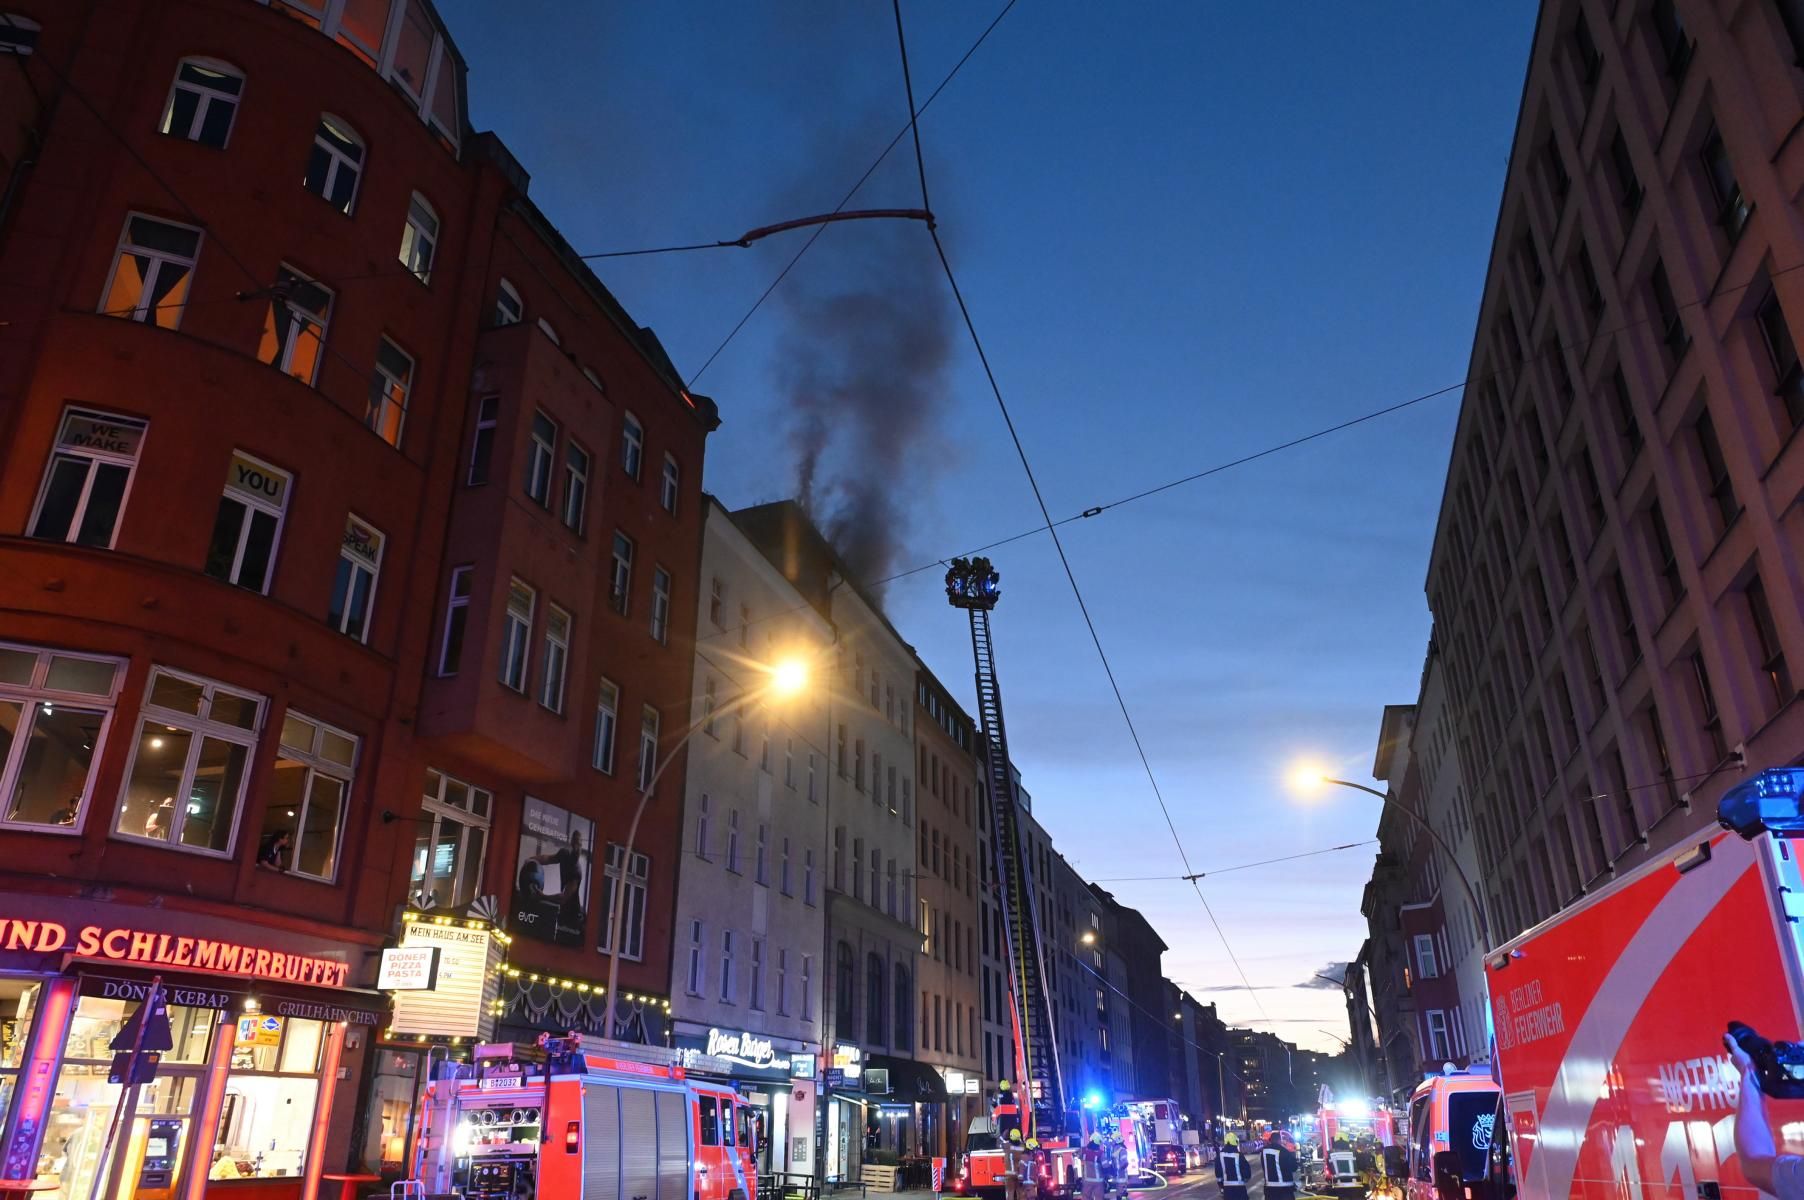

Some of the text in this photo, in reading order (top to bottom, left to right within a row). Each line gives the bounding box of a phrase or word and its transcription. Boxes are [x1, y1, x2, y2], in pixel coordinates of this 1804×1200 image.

[74, 433, 129, 453] MAKE
[92, 423, 119, 438] WE
[237, 464, 279, 497] YOU
[529, 808, 542, 820] DIE
[528, 822, 569, 841] GENERATION
[410, 926, 485, 944] MEIN HAUS AM SEE
[75, 925, 349, 988] SCHLEMMERBUFFET
[387, 970, 422, 978] PASTA
[103, 980, 230, 1009] DÖNR KEBAP
[1510, 979, 1543, 1013] BERLINER
[278, 1001, 379, 1026] GRILLHÄHNCHEN
[1514, 1002, 1565, 1046] FEUERWEHR
[707, 1028, 740, 1056] Rosen
[740, 1032, 774, 1064] Burger
[1659, 1053, 1741, 1113] NOTRU
